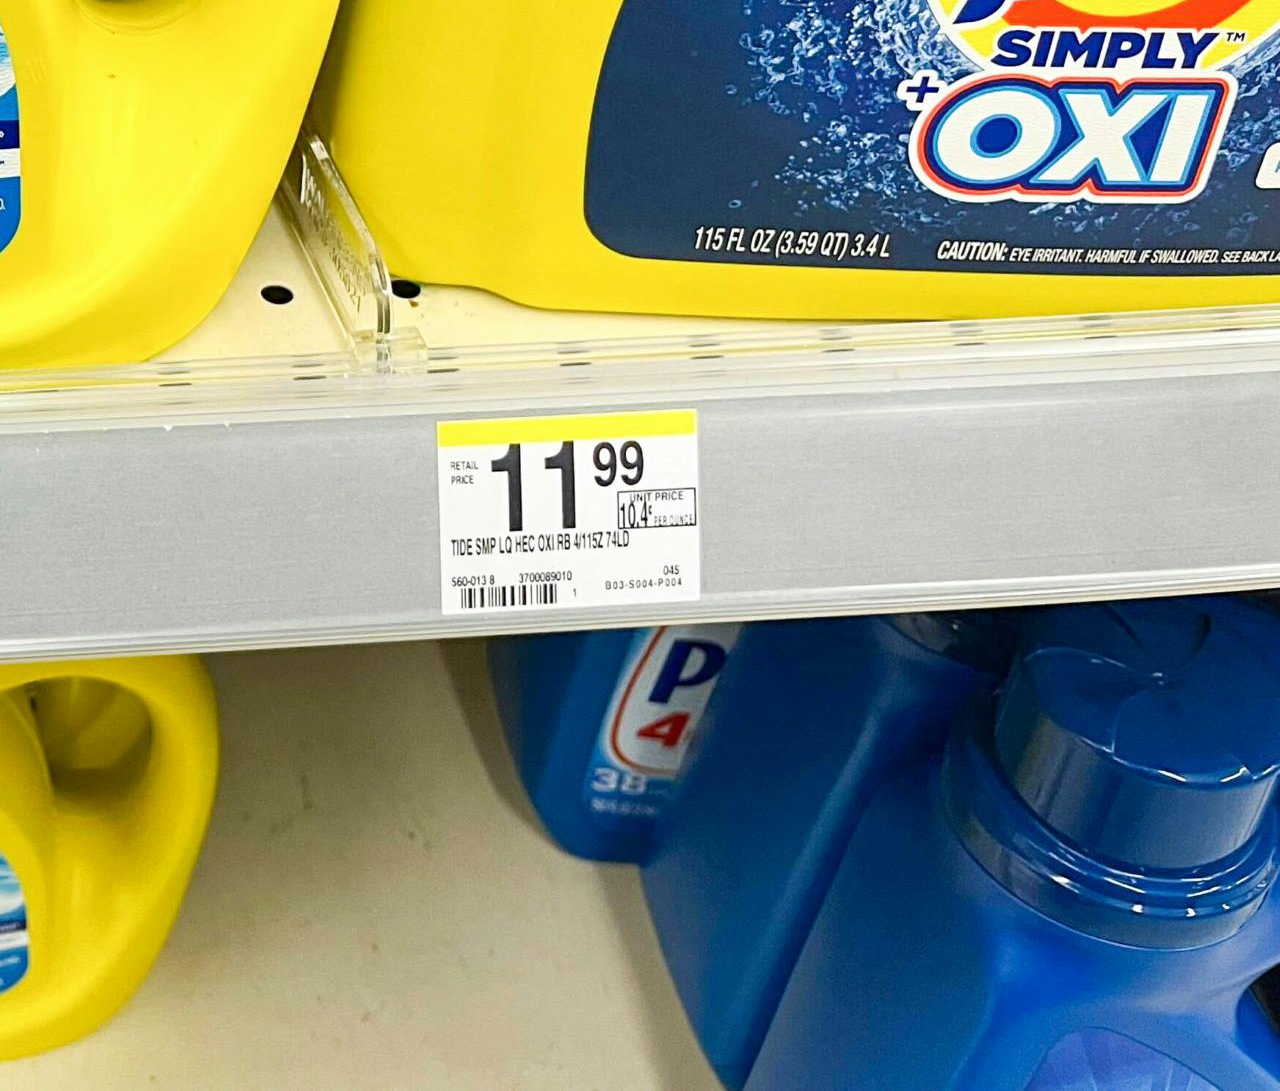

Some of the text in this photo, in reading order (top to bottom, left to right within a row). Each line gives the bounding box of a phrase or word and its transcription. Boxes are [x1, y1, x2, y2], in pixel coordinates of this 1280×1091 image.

[931, 84, 1216, 183] OXI
[695, 226, 890, 261] 115 FL OZ (3.59 QT) 3.4 L
[937, 240, 1268, 264] CAUTION: EYE IRRITANT. HARMFUL IF SWALLOWED. SEE BACK
[451, 461, 479, 470] RETAIL
[451, 475, 474, 484] PRICE
[630, 491, 684, 503] UNIT PRICE
[654, 514, 693, 525] PER OUNCE
[451, 530, 630, 556] TIDE SMP LQ HEC OXI RB 4/115Z 74LD
[663, 565, 680, 576] 045
[591, 767, 646, 795] 38
